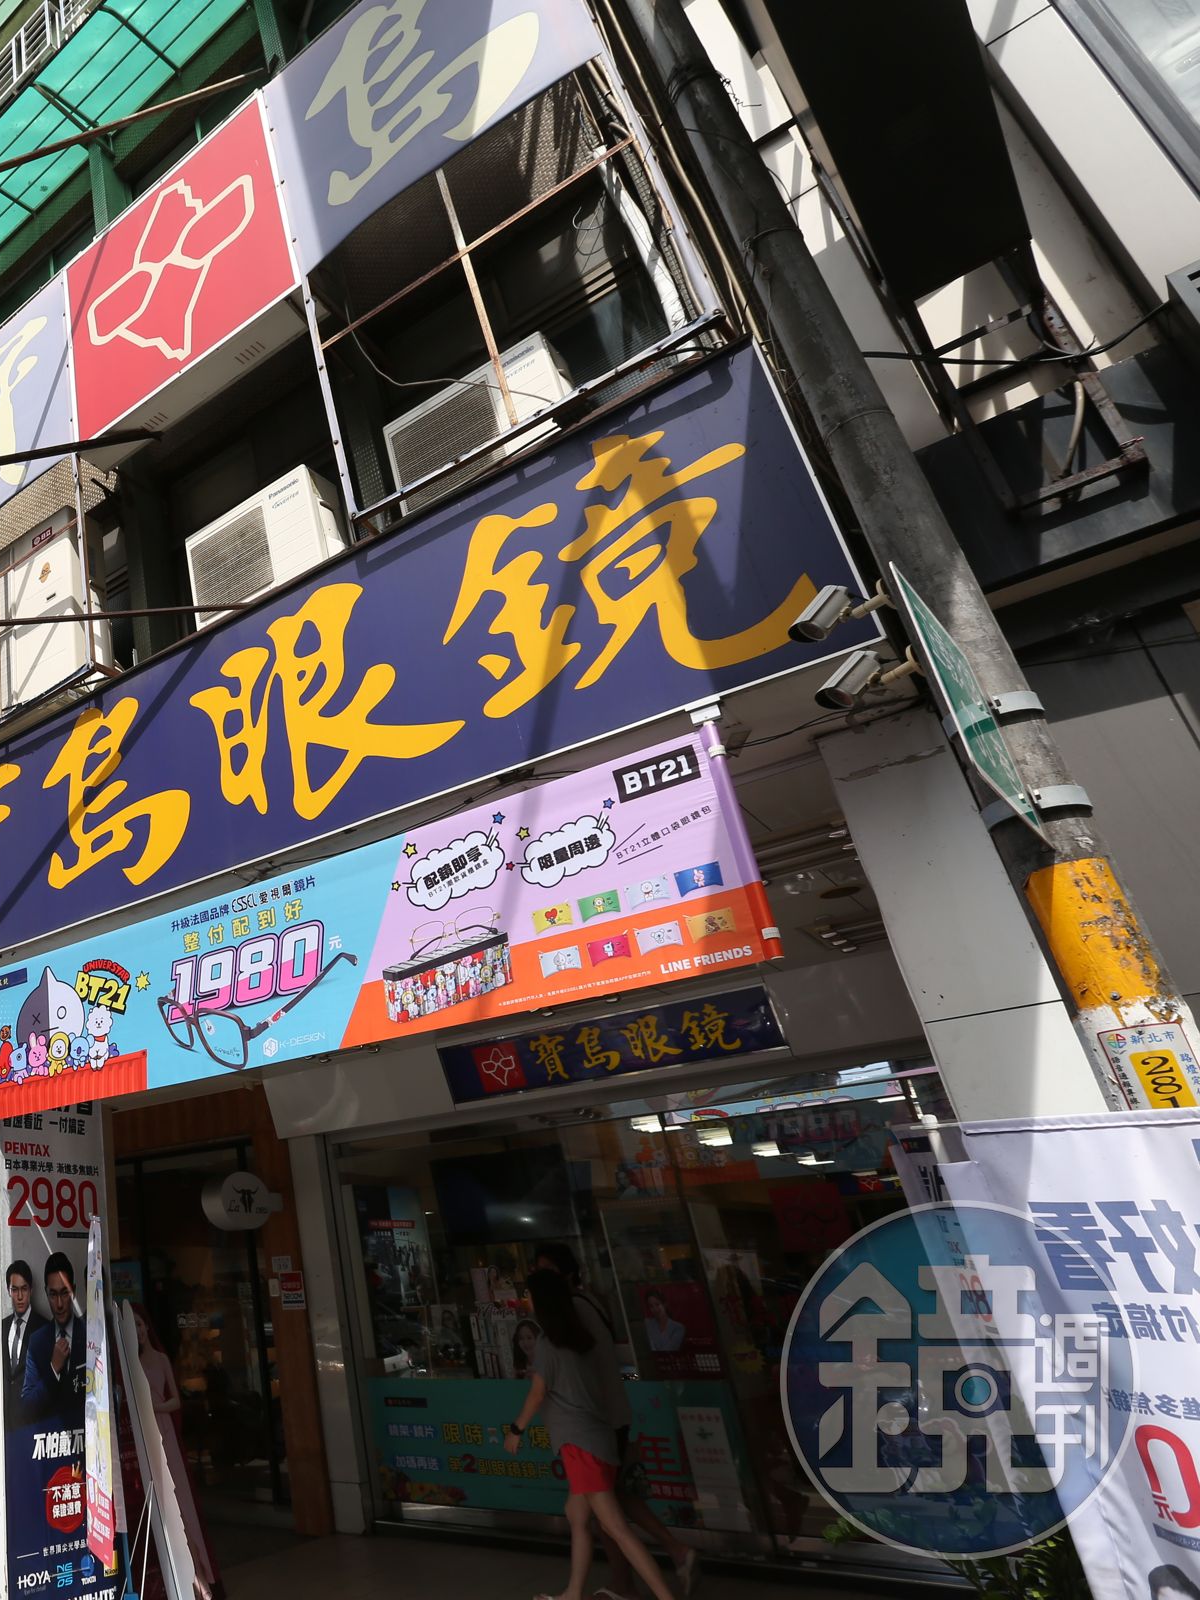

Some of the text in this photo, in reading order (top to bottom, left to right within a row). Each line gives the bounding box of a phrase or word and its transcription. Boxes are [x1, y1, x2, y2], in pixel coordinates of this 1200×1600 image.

[501, 345, 535, 367] anasonic
[268, 478, 300, 500] Panasonic
[622, 754, 693, 795] BT21
[423, 845, 482, 890] 配鏡即享
[536, 832, 603, 872] 限量周邊
[171, 904, 230, 932] 升級法國品牌
[183, 899, 303, 953] 整付配到好
[82, 958, 132, 983] UNIVERSTAR
[166, 919, 325, 1023] 1980
[660, 945, 754, 976] LINE FRIENDS
[74, 970, 131, 1014] BT21
[529, 1003, 743, 1083] 寶島眼鏡
[1130, 1030, 1175, 1046] 新北市
[4, 1141, 51, 1158] PENTAX
[7, 1175, 98, 1229] 2980
[17, 1570, 51, 1590] HOYA
